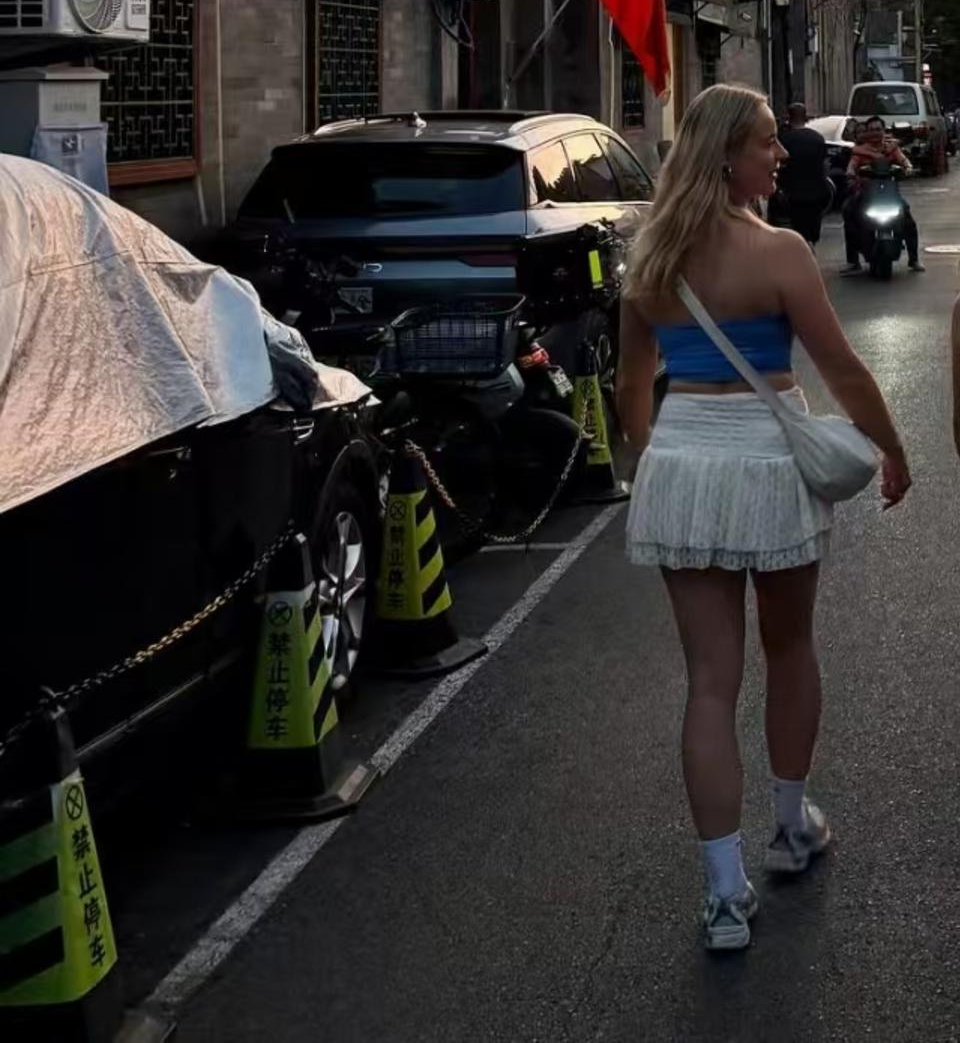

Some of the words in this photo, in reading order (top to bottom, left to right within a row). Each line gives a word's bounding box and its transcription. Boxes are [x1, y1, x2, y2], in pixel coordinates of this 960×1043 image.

[265, 632, 292, 741] 禁止停车
[72, 823, 107, 968] 禁止停车
